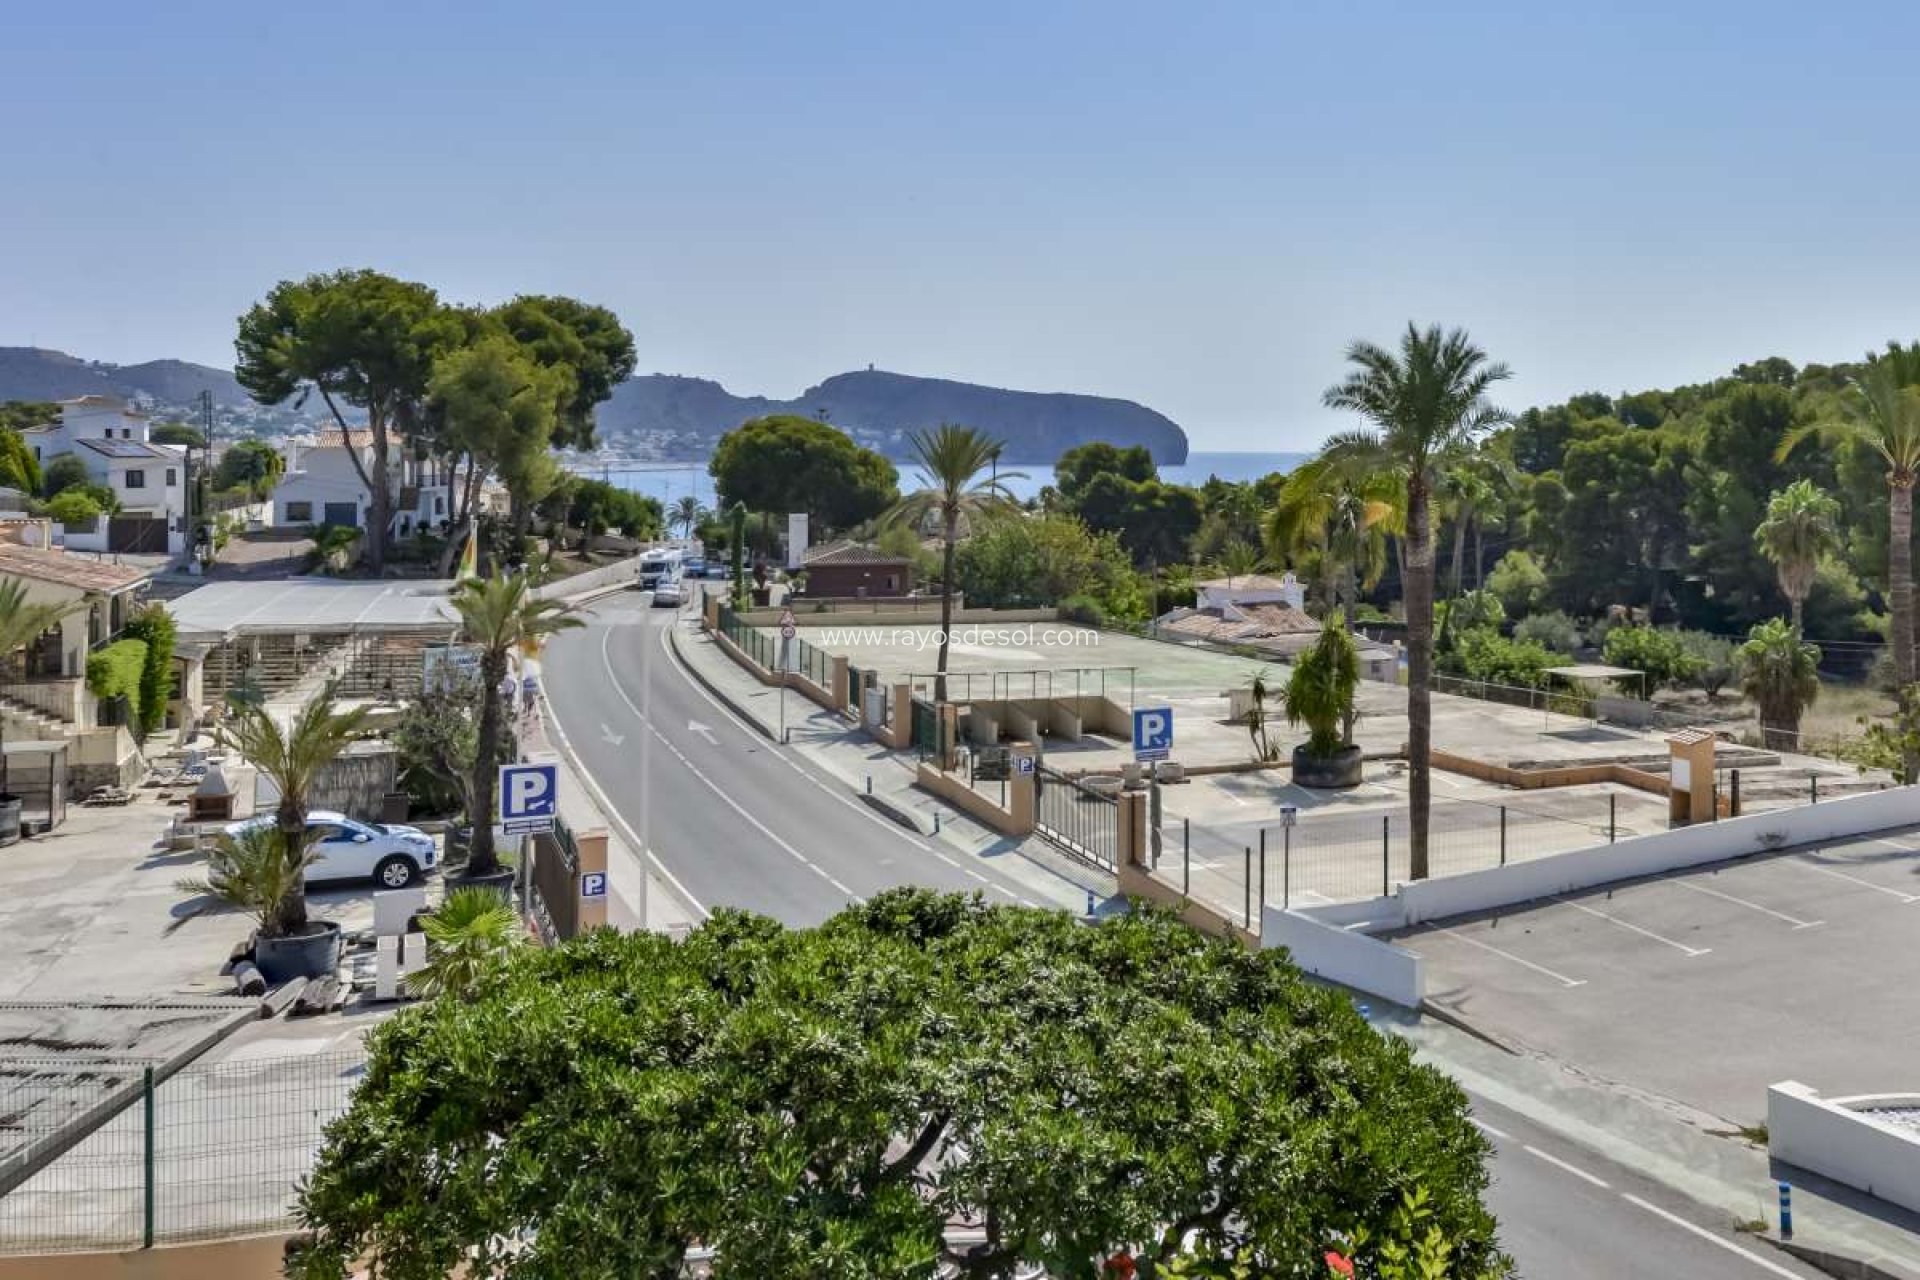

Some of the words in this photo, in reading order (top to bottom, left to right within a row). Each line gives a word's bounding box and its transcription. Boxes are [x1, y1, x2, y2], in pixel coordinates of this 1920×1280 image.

[1142, 714, 1165, 747] P
[510, 773, 548, 814] P
[585, 876, 602, 894] P
